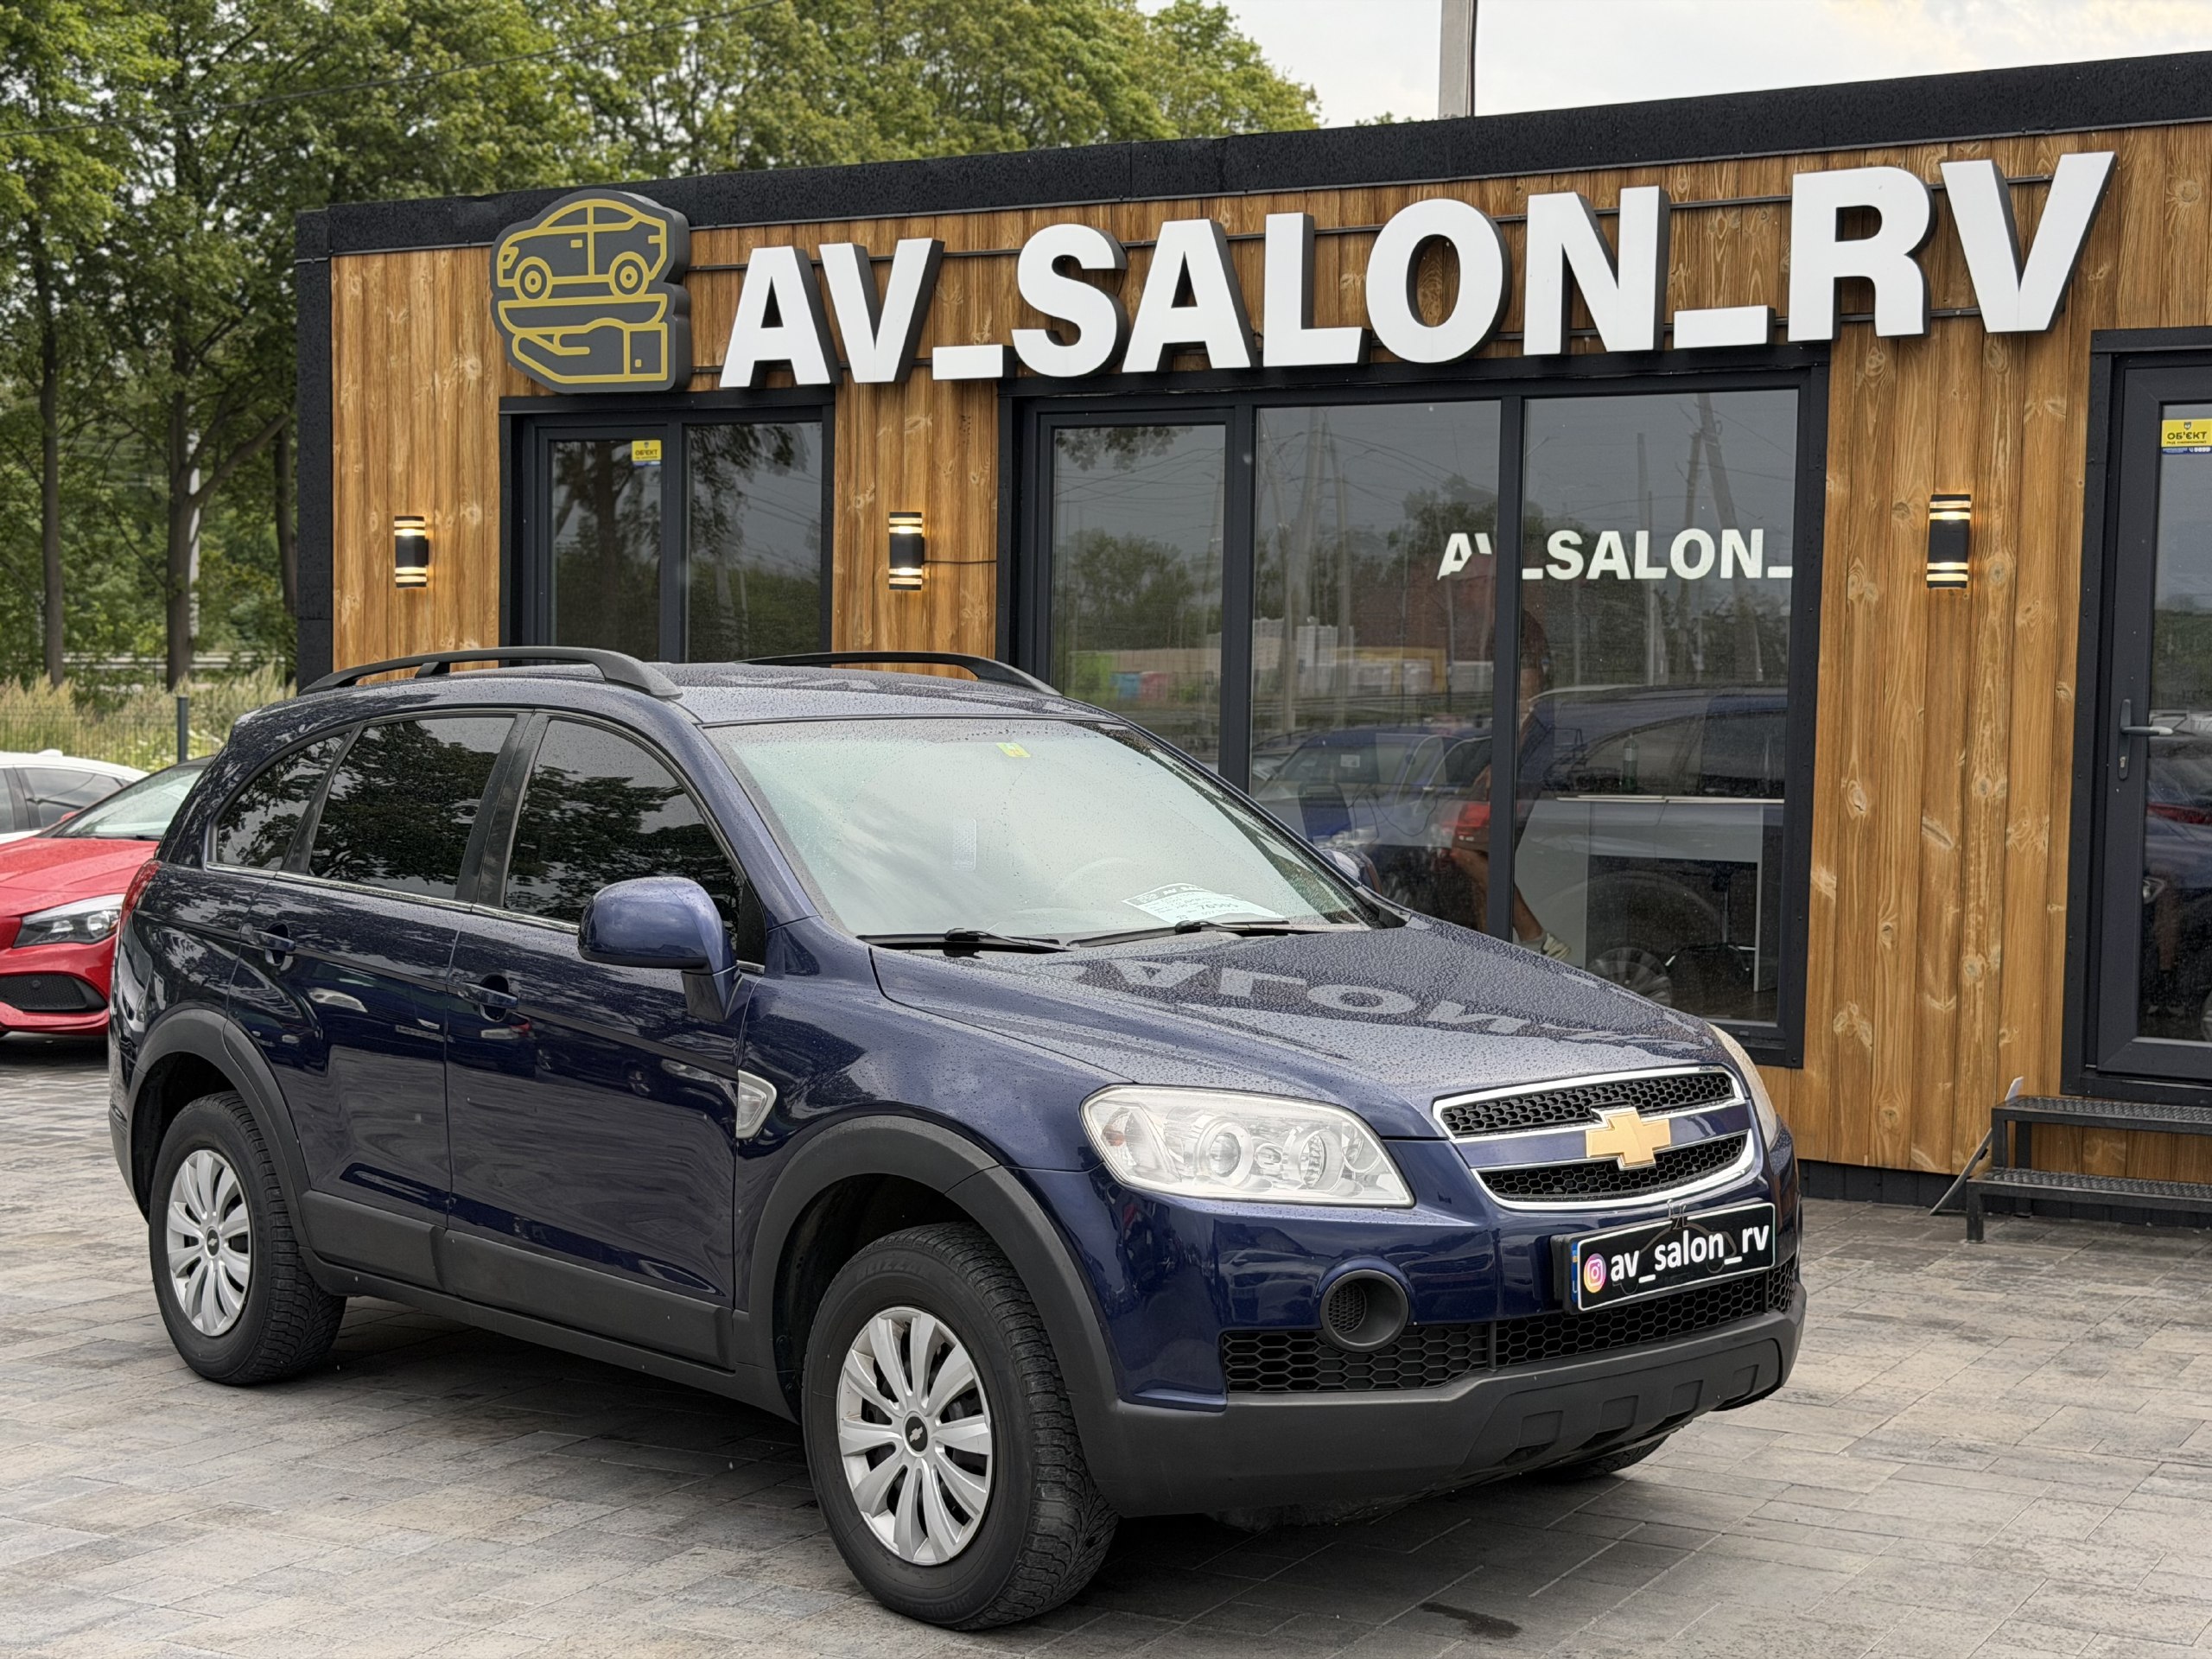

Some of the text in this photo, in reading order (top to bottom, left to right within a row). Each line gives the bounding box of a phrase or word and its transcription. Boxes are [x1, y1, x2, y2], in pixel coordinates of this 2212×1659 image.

[719, 150, 2116, 389] AV_SALON_RV
[2167, 431, 2207, 440] ОБ'ЄКТ
[1611, 1225, 1769, 1284] av_salon_rv
